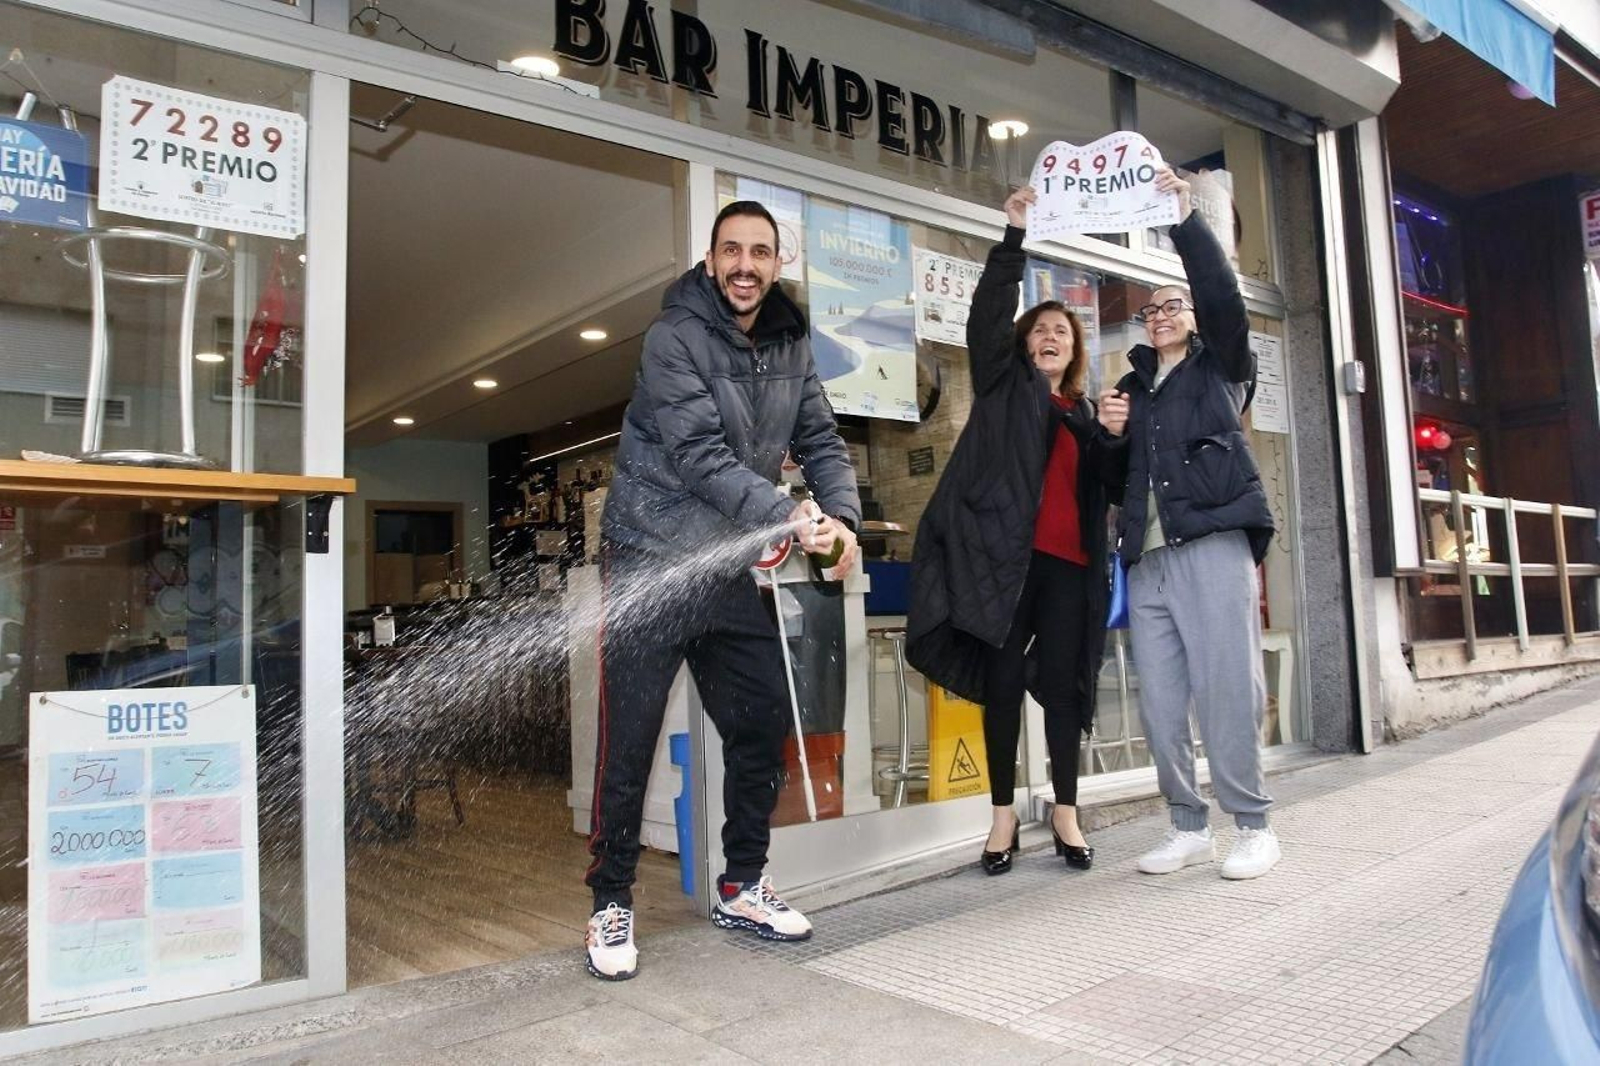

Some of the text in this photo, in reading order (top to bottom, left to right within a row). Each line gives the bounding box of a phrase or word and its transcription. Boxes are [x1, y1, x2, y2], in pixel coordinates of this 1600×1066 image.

[553, 0, 718, 99] BAR
[0, 127, 21, 145] AY
[129, 97, 283, 154] 72289
[1, 144, 67, 182] ERÍA
[162, 141, 278, 183] PREMIO
[1043, 144, 1154, 174] 94974
[0, 174, 66, 203] AVIDAD
[1064, 164, 1156, 194] PREMIO
[820, 229, 900, 265] INVIERNO
[107, 701, 188, 734] BOTES
[72, 763, 117, 795] 54
[184, 758, 213, 788] 7
